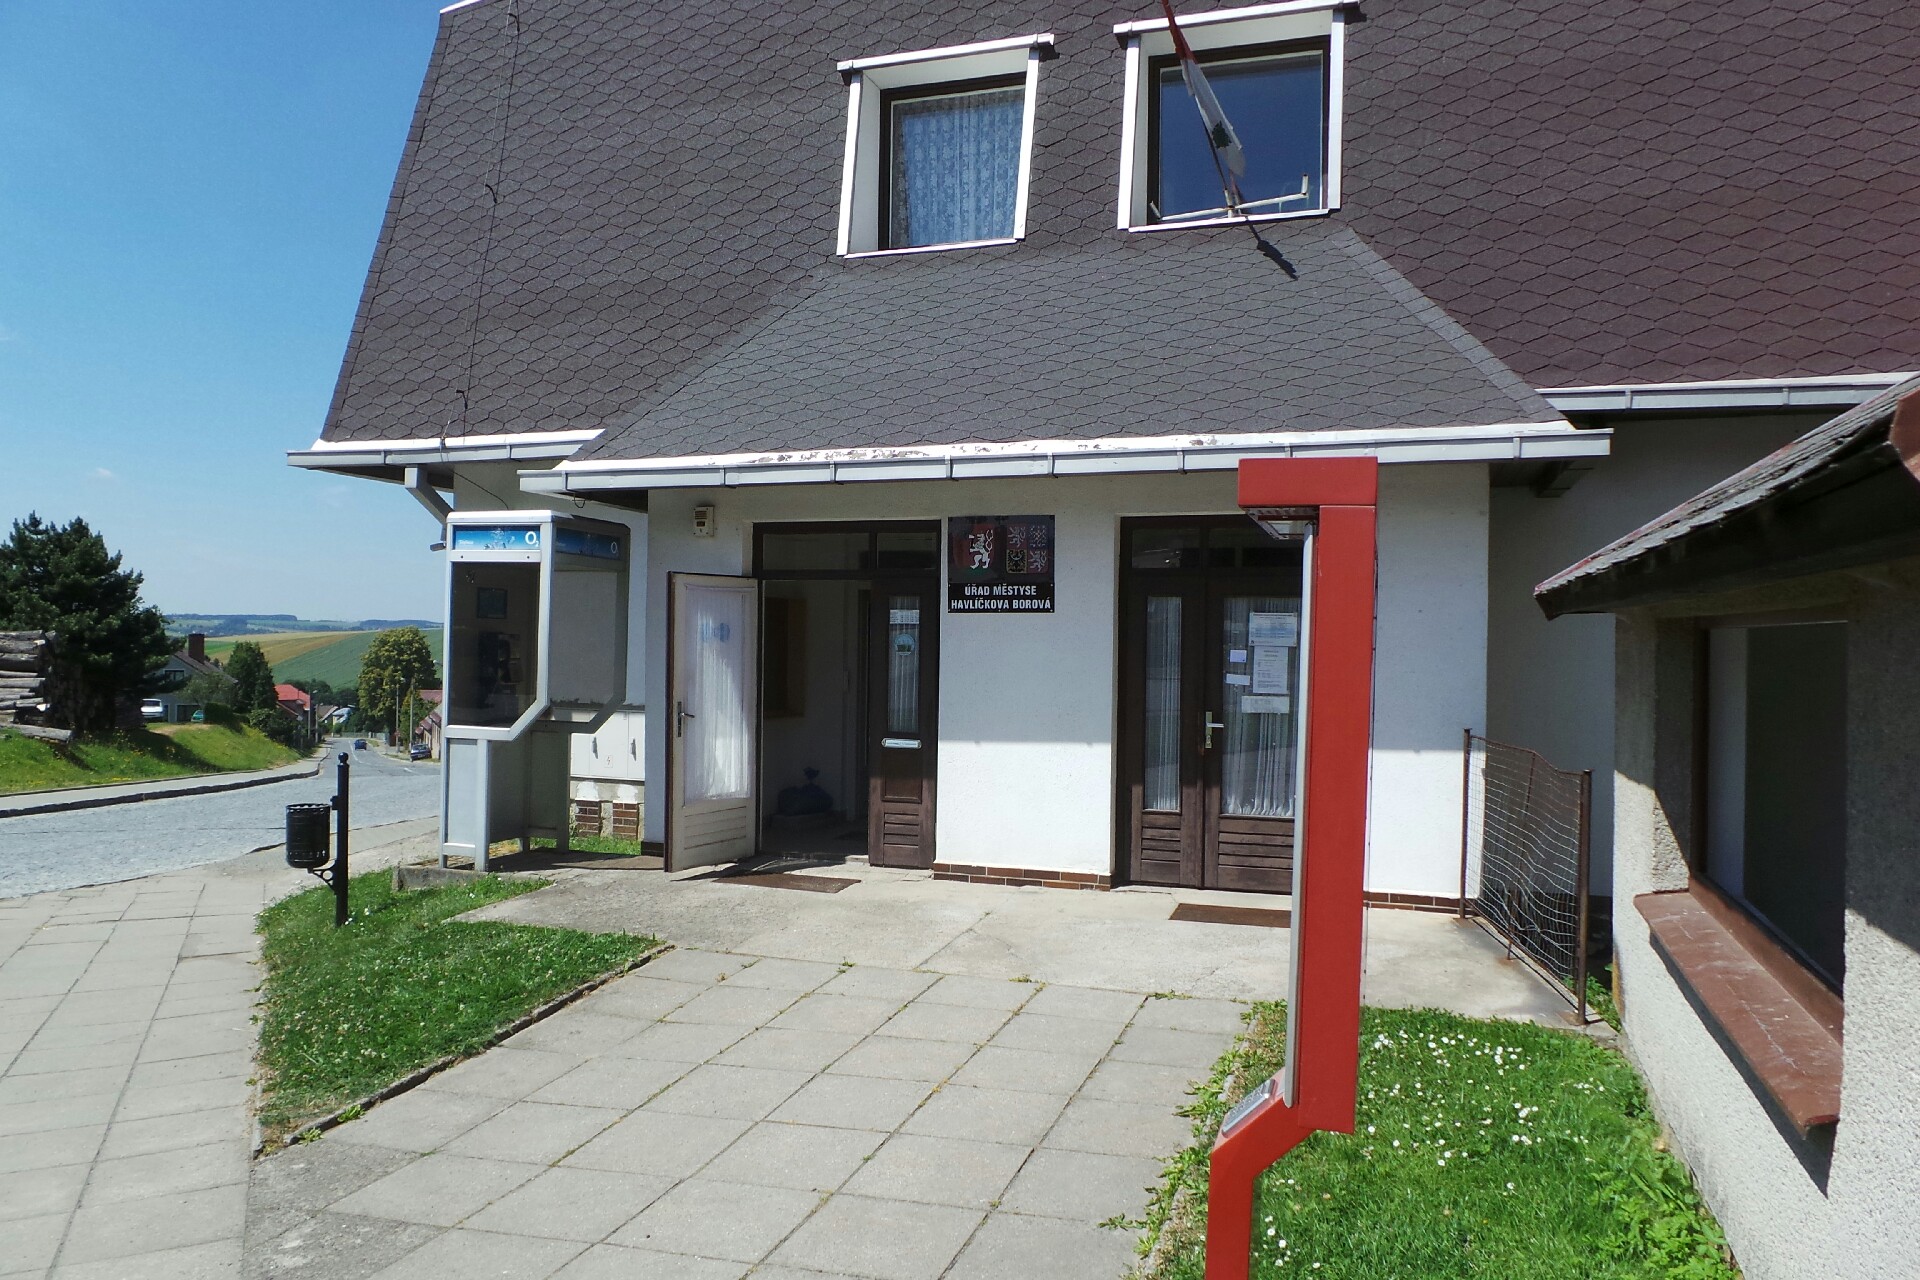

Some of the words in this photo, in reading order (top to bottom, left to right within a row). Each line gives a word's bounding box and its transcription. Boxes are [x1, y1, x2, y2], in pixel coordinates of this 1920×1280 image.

[964, 583, 990, 596] ÚŘAD
[993, 583, 1037, 596] MĚSTYSE
[951, 597, 1010, 610] HAVLÍČKOVA
[1012, 596, 1051, 610] BOROVÁ
